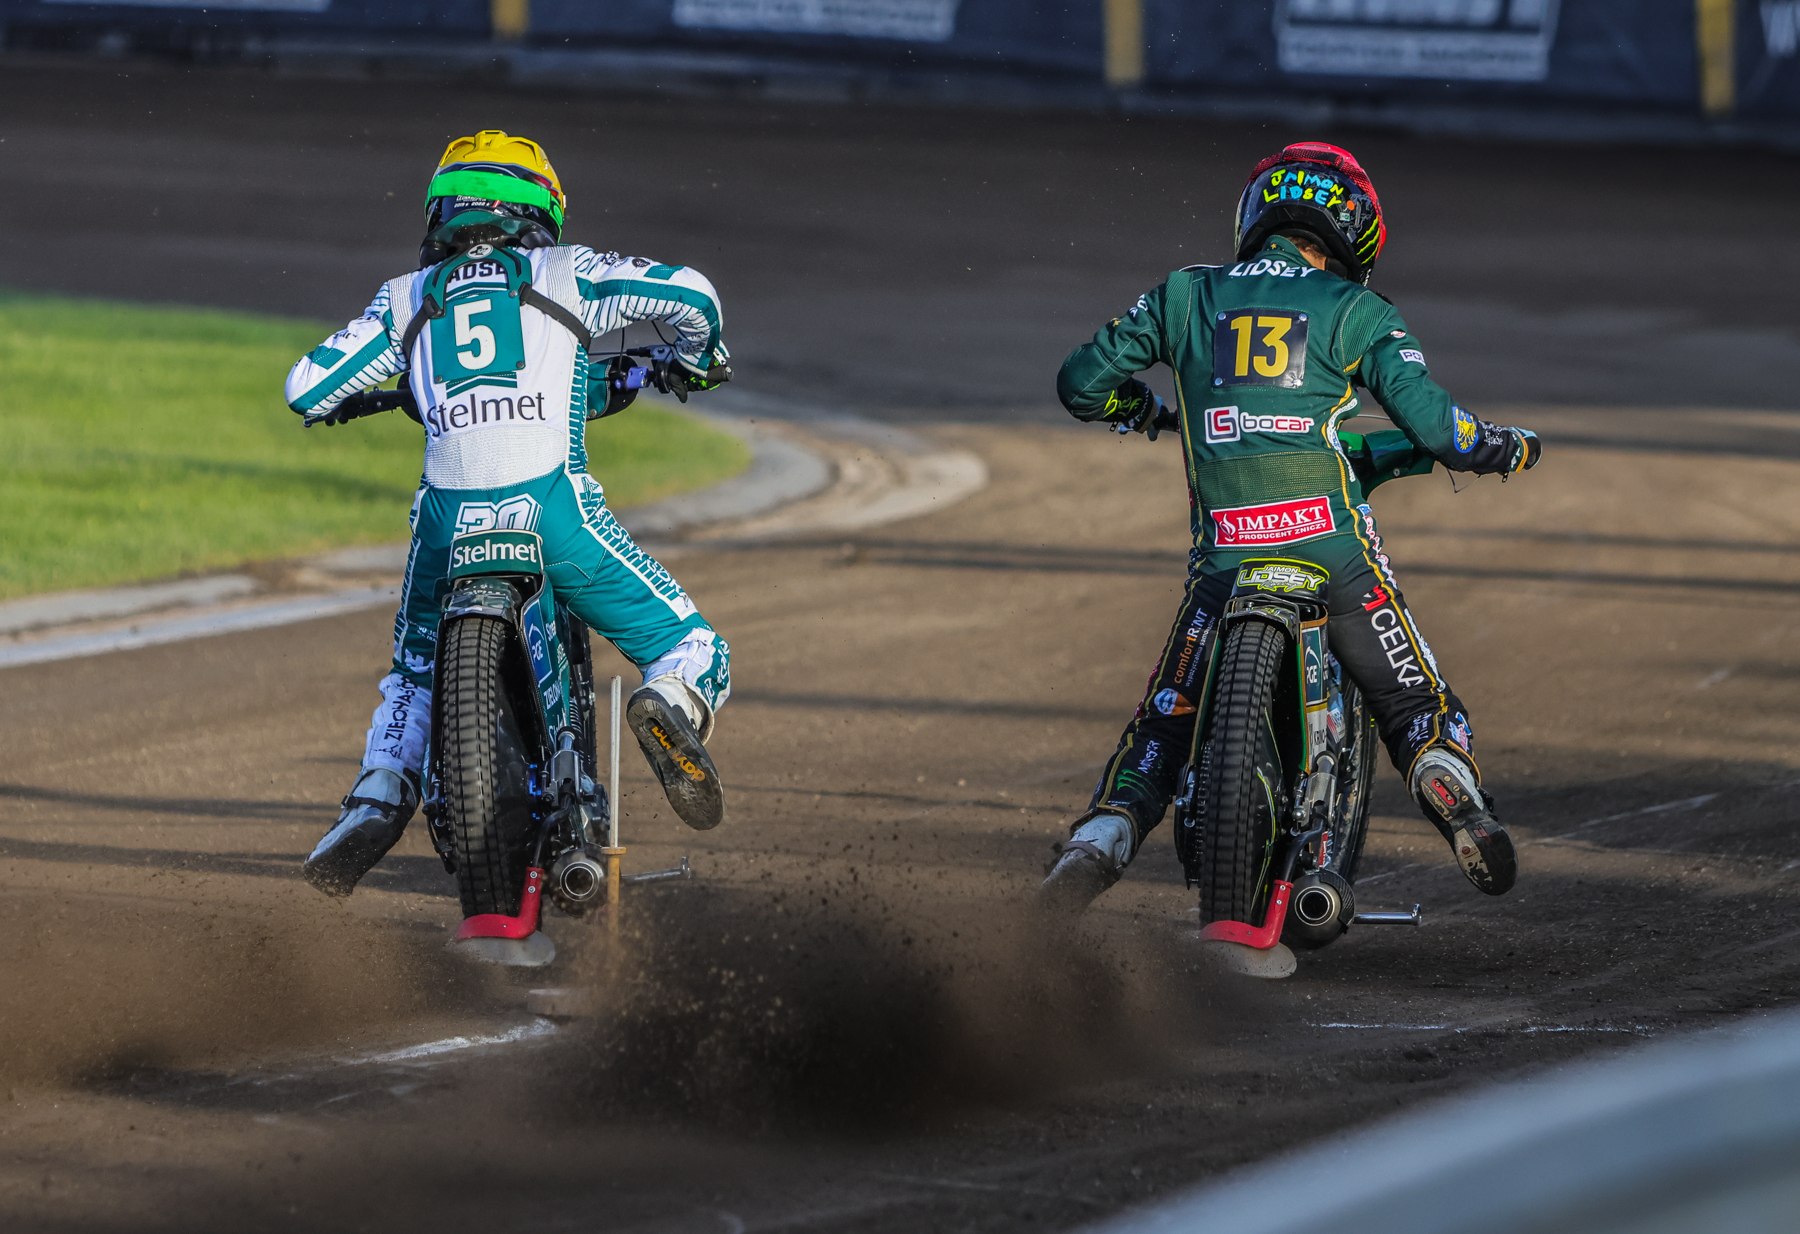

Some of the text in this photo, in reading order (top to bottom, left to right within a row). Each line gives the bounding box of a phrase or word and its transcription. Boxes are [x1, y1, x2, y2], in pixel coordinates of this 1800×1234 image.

[1271, 169, 1344, 196] JAIMON
[1263, 185, 1342, 208] LIDSEY
[1228, 258, 1317, 278] LIDSEY
[453, 298, 496, 370] 5
[1230, 316, 1292, 378] 13
[426, 392, 546, 437] Stelmet
[1242, 414, 1313, 431] bocar
[1236, 506, 1324, 531] IMPAKT
[1238, 522, 1327, 540] PRODUCENT ZNICZY
[453, 539, 537, 568] Stelmet
[1238, 570, 1322, 588] LIDSEY
[1264, 566, 1299, 574] JAIMON
[1174, 608, 1207, 684] comfortRNT
[1371, 608, 1425, 688] CELKA
[1306, 664, 1318, 684] PGE
